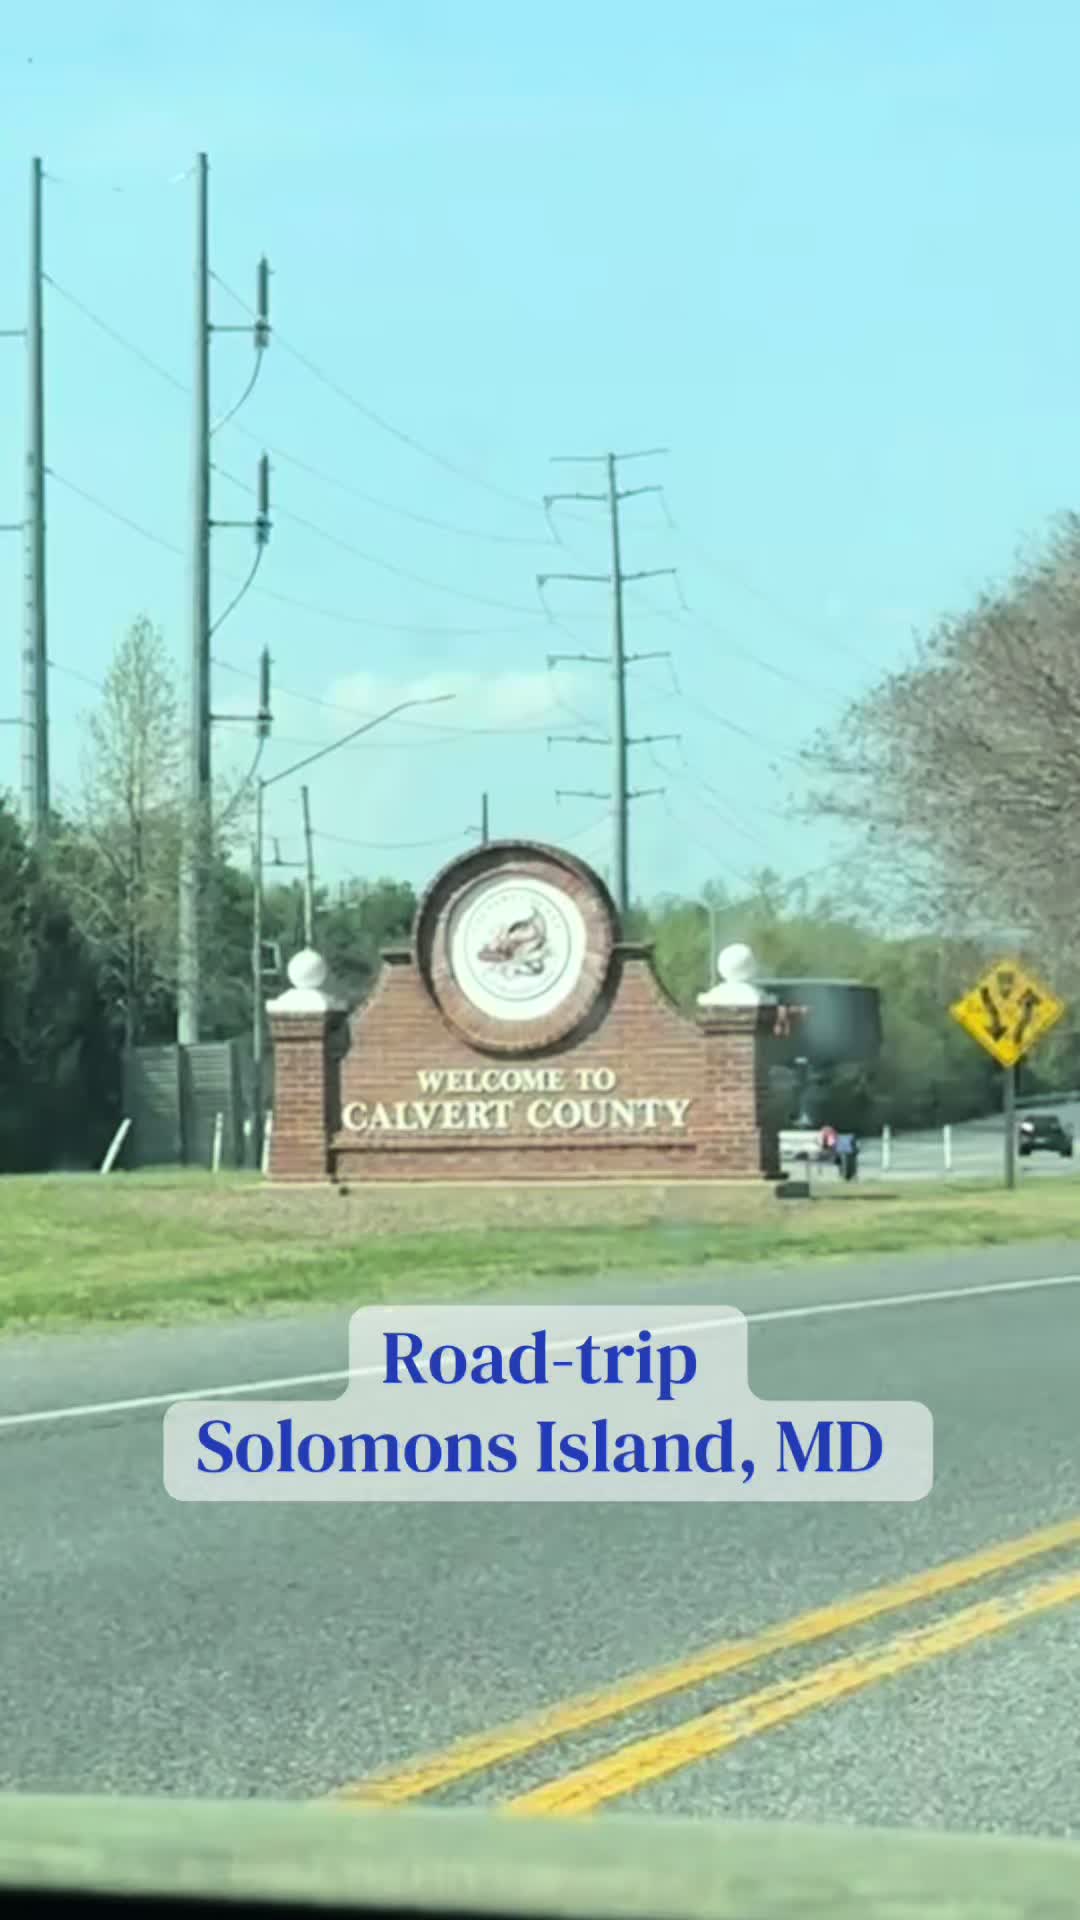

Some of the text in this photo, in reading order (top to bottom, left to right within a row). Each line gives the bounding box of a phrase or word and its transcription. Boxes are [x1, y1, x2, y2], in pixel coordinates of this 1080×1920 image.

[416, 1067, 617, 1093] WELCOME TO
[341, 1098, 691, 1131] CALVERT COUNTY
